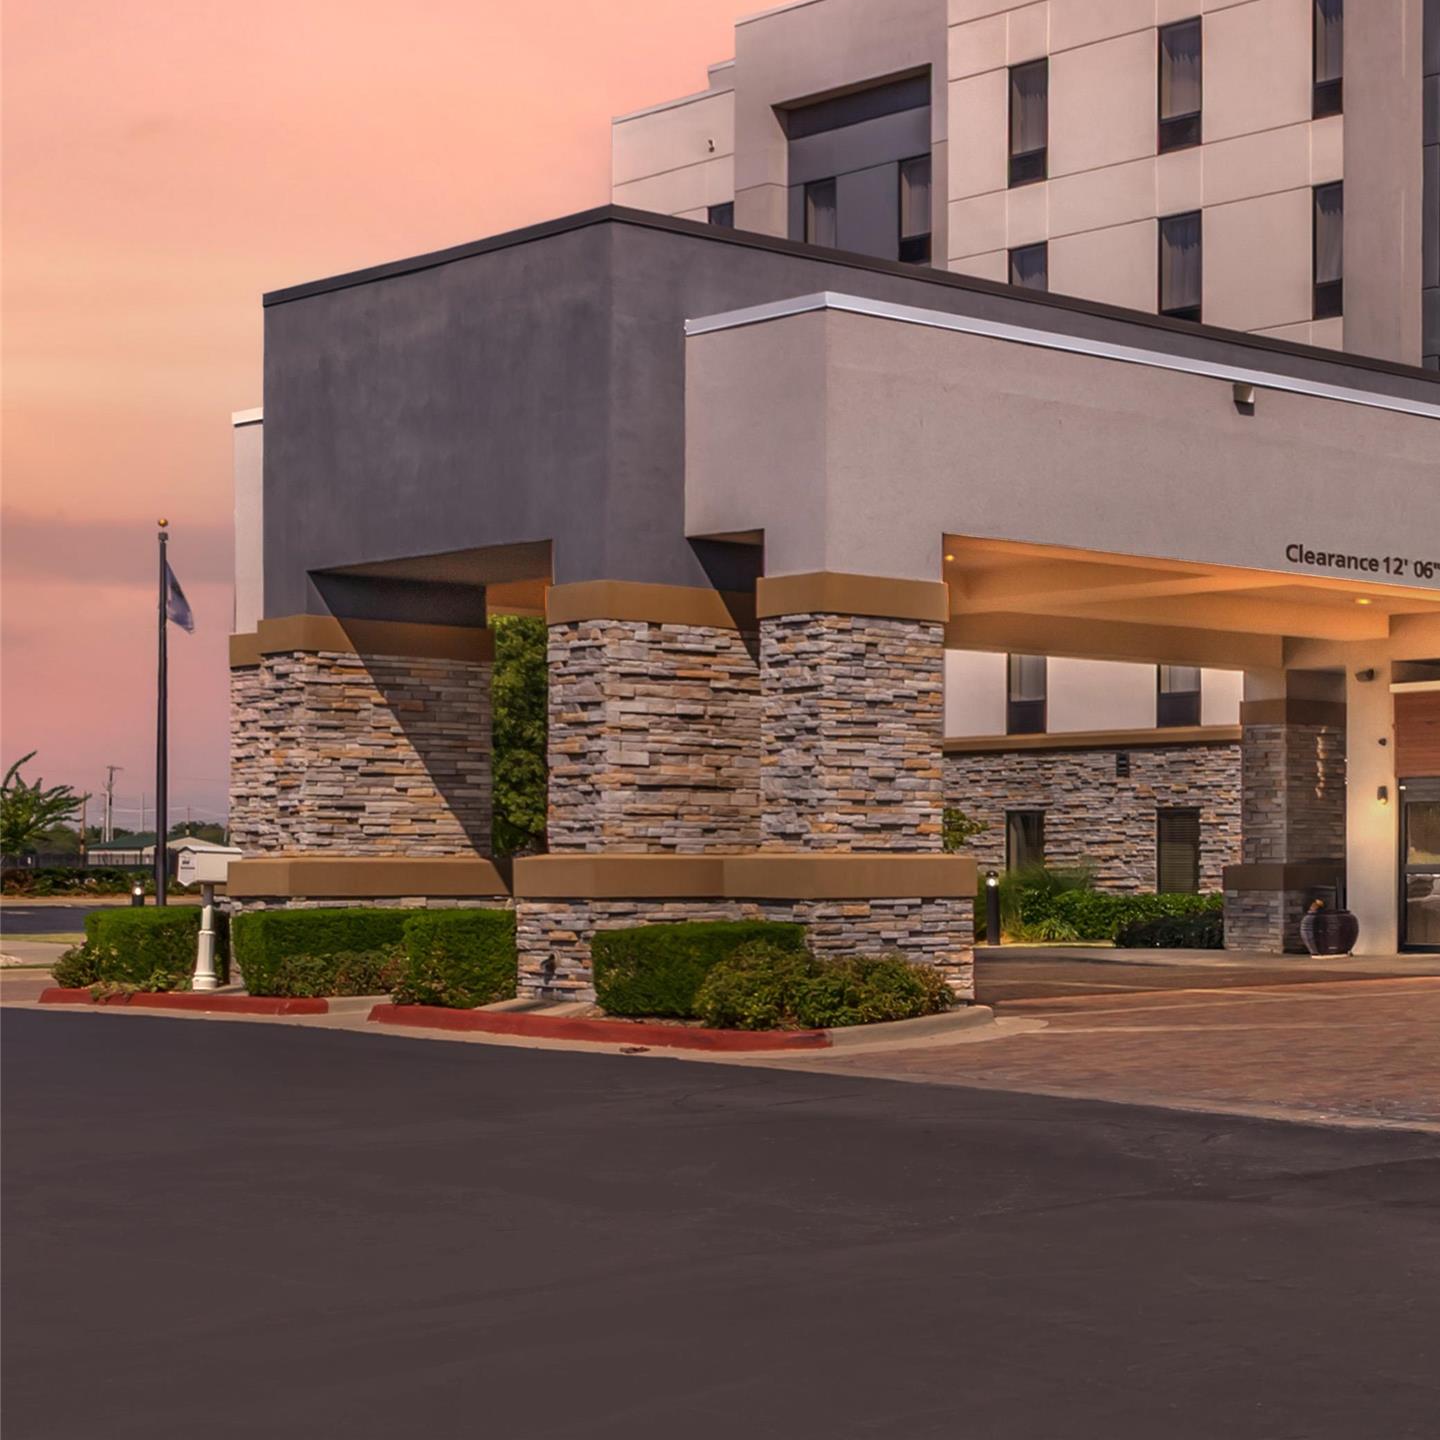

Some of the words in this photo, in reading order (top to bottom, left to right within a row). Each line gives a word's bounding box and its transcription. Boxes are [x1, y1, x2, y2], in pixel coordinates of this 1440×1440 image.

[1286, 544, 1379, 572] Clearance
[1384, 556, 1408, 575] 12'
[1414, 560, 1440, 579] 06"
